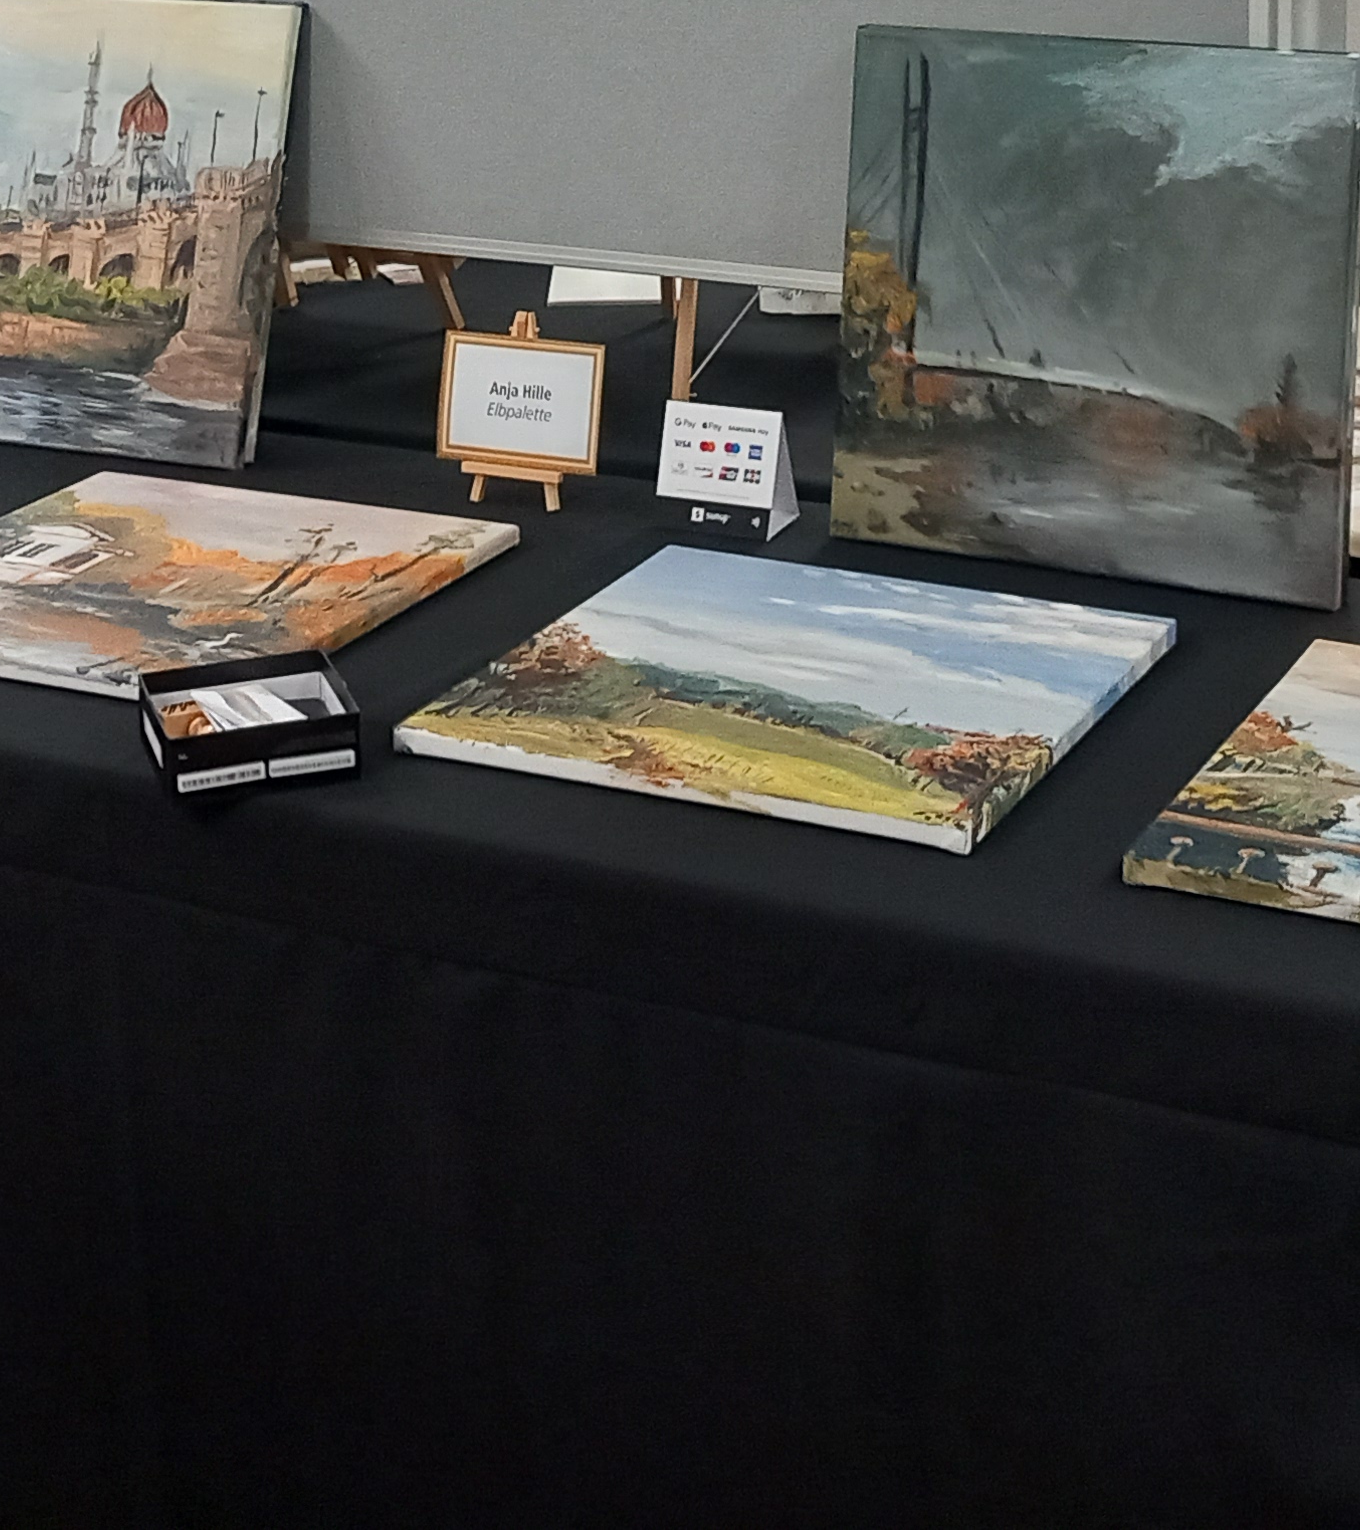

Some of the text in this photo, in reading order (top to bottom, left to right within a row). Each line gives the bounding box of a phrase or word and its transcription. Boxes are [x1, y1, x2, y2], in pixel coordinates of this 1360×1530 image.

[489, 381, 552, 401] Anja Hille
[487, 402, 552, 422] Elbpalette
